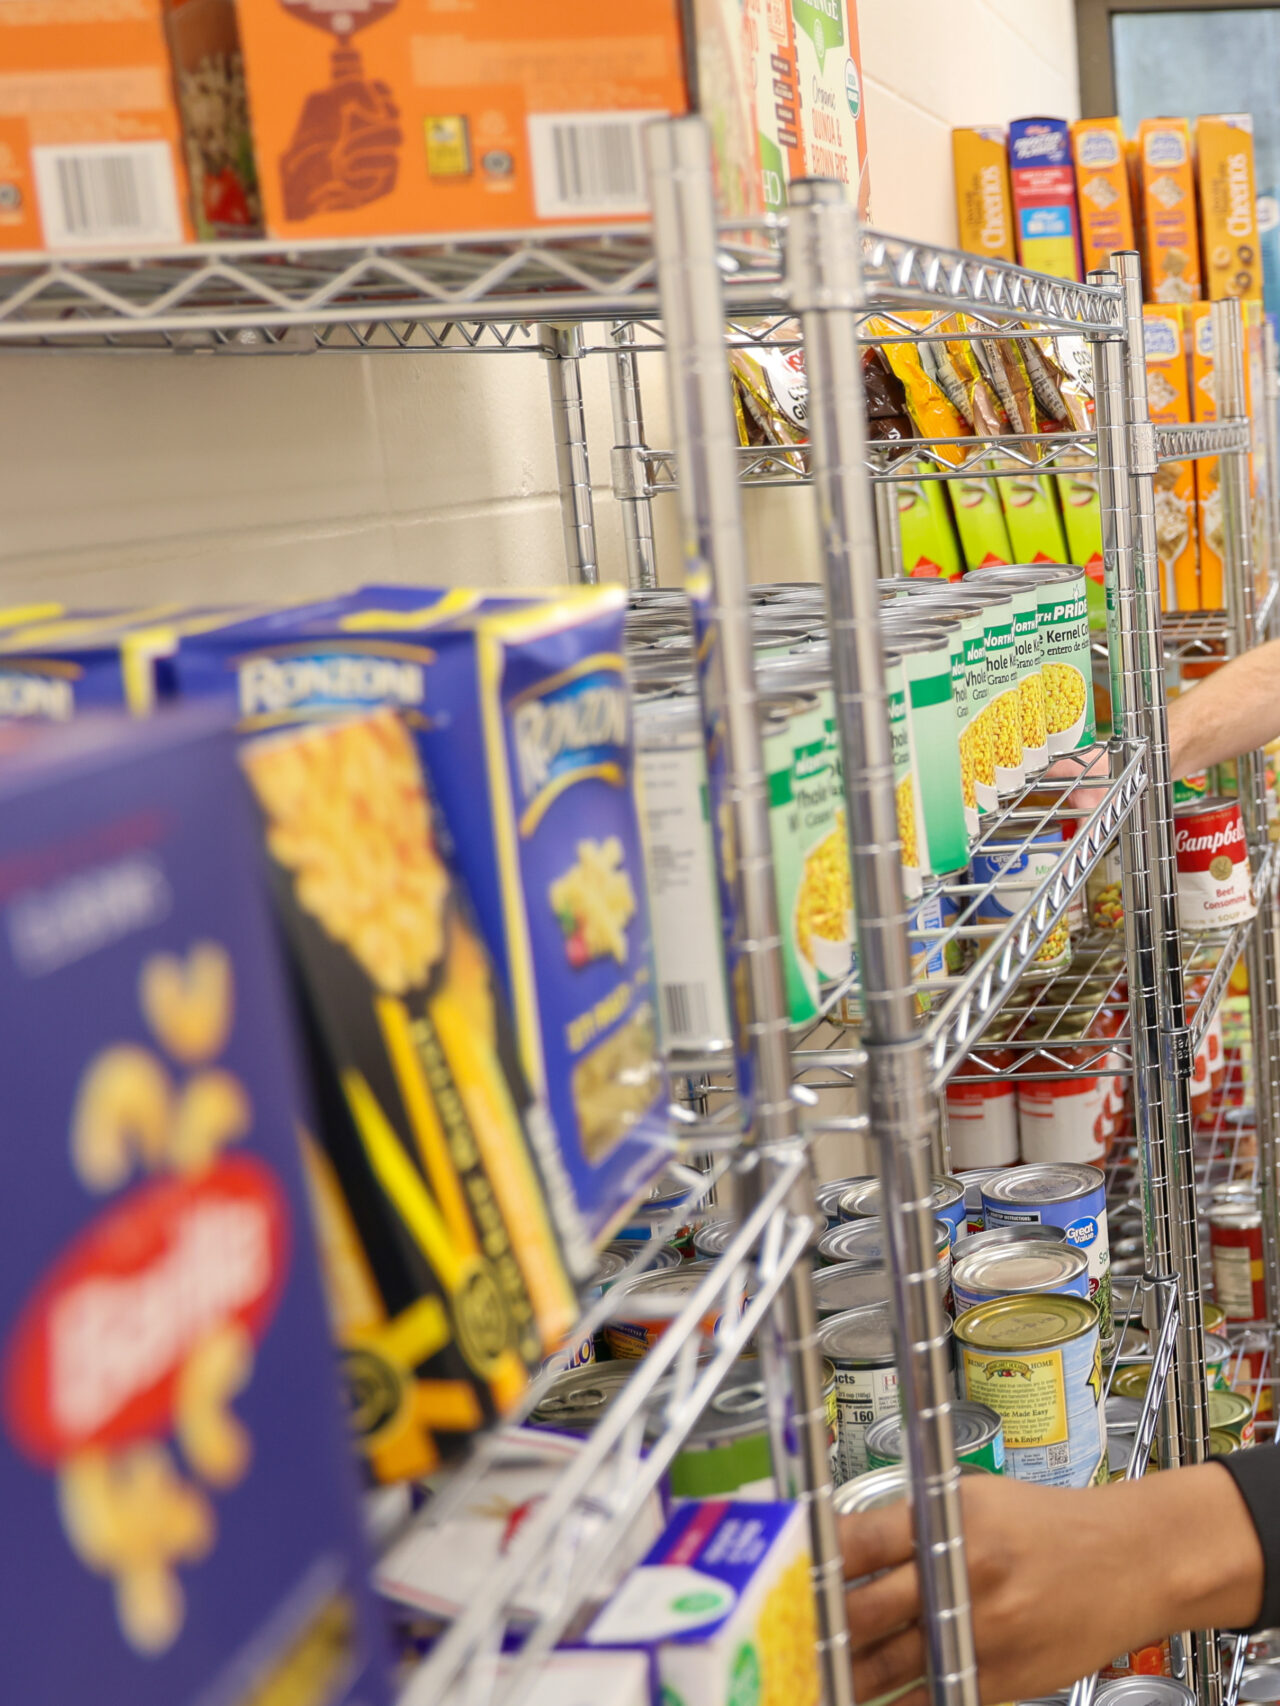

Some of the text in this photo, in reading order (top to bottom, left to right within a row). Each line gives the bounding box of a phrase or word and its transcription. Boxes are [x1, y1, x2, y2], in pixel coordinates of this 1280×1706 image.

[1226, 153, 1253, 238] Cheerios
[1046, 625, 1081, 644] Kernel
[1015, 640, 1032, 656] hole
[1047, 642, 1072, 656] entero
[985, 656, 1008, 672] hole
[987, 672, 1010, 686] Grano
[1175, 816, 1247, 854] Campbell
[1215, 886, 1235, 898] Beef
[1217, 911, 1241, 923] SOUP
[1066, 1221, 1095, 1239] Great
[1074, 1231, 1095, 1244] Value
[1030, 1359, 1054, 1369] HOME
[834, 1373, 856, 1385] cts
[853, 1410, 874, 1423] 160
[1011, 1408, 1031, 1418] Made
[1032, 1407, 1049, 1418] Easy
